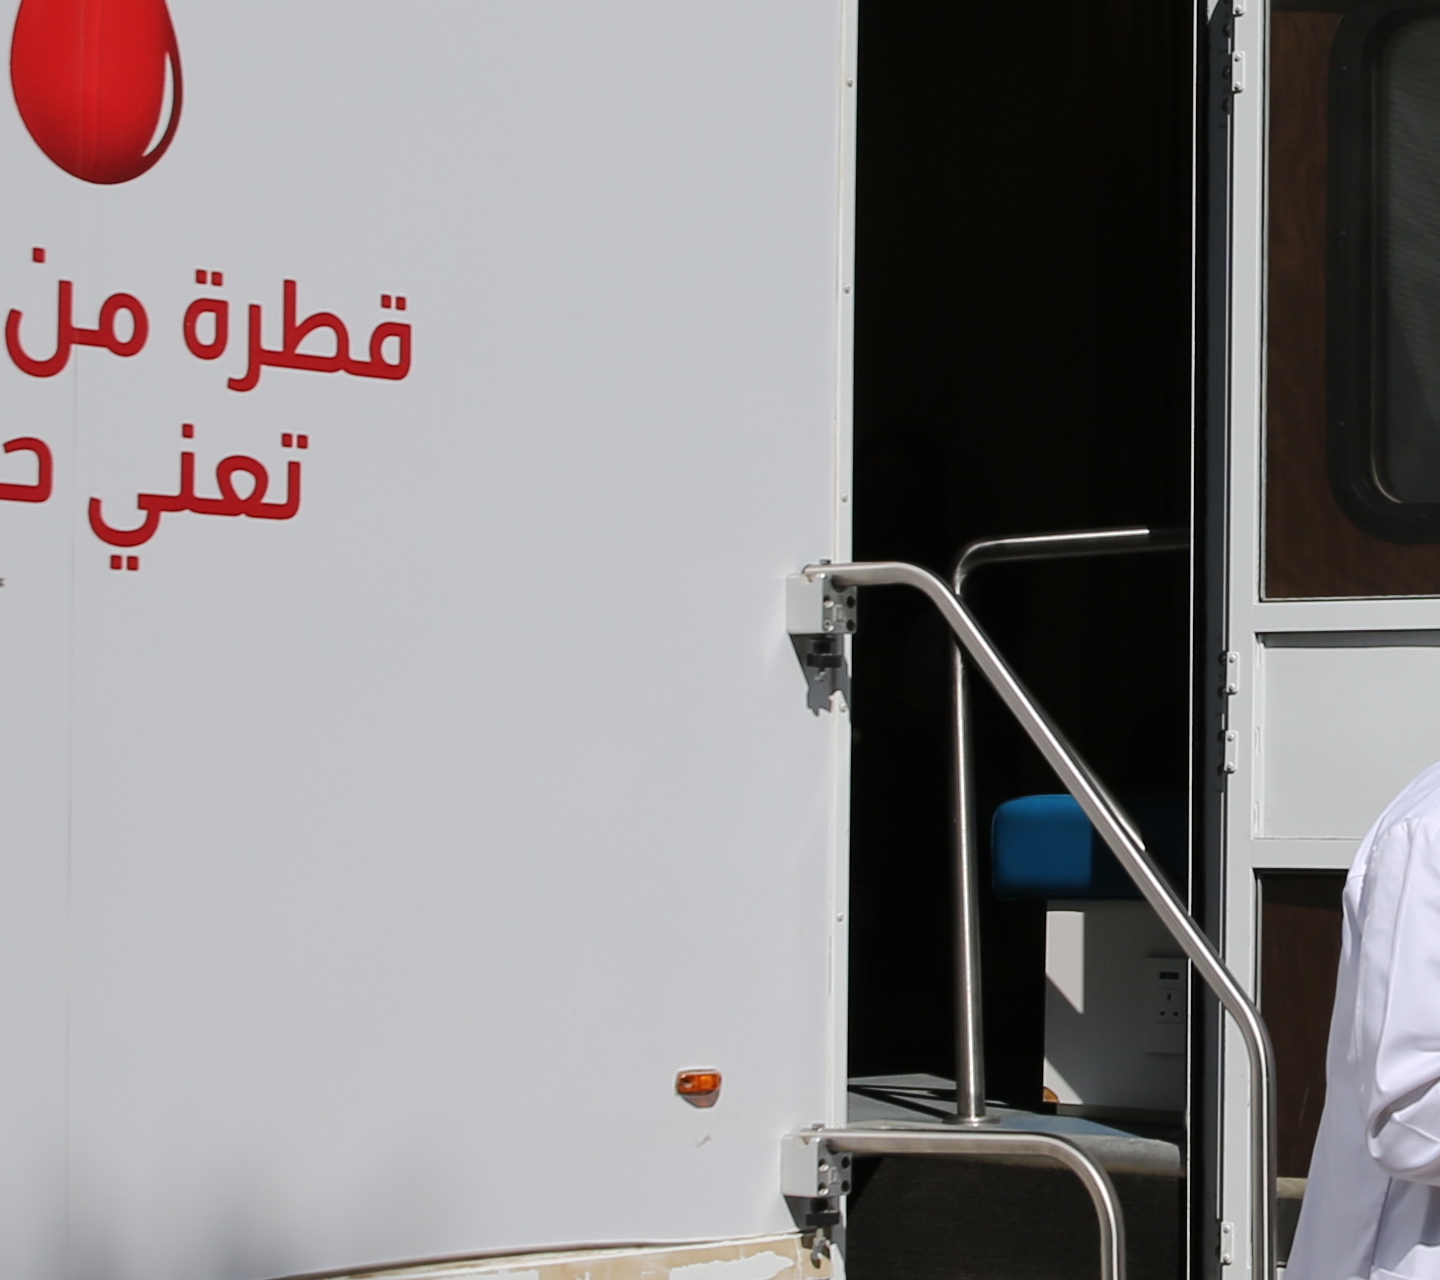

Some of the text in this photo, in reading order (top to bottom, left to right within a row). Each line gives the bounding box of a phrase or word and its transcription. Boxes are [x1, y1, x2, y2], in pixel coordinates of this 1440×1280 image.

[5, 247, 151, 379] من
[183, 269, 413, 393] قطرة
[88, 423, 310, 572] تعني
